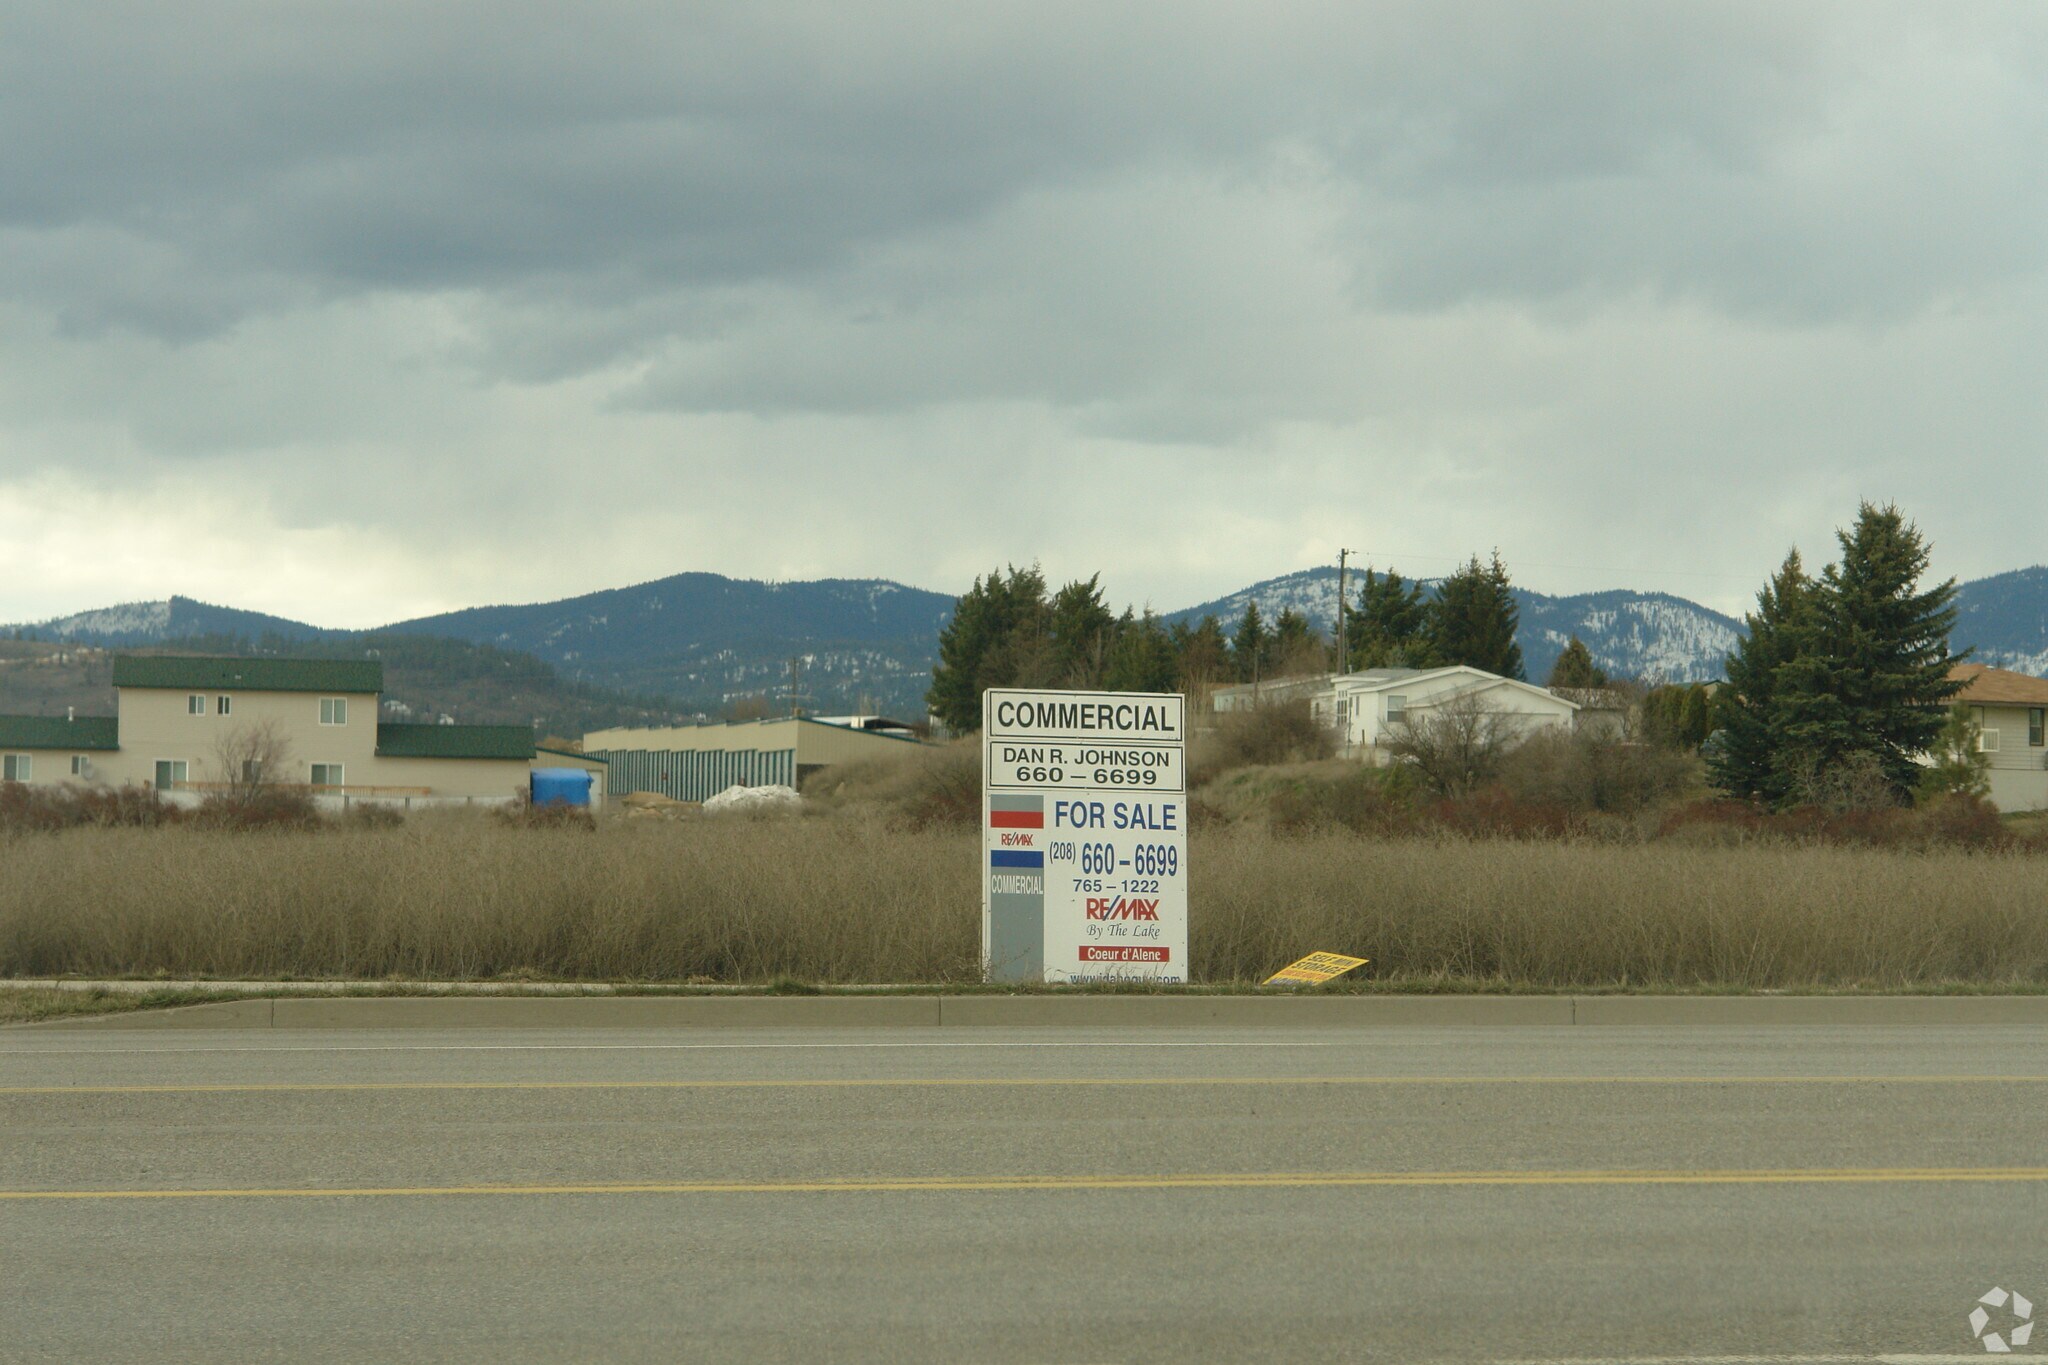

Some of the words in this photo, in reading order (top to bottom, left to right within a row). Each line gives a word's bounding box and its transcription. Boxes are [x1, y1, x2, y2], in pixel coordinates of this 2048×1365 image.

[998, 701, 1175, 731] COMMERCIAL
[1003, 748, 1044, 763] DAN
[1050, 749, 1068, 764] R.
[1075, 750, 1169, 767] JOHNSON
[1055, 801, 1105, 828] FOR
[1114, 802, 1176, 830] SALE
[1001, 832, 1033, 846] RE/MAX
[1050, 842, 1076, 864] (208)
[991, 875, 1044, 895] COMMERCIAL
[1086, 895, 1160, 921] RE/MAX
[1087, 924, 1103, 940] By
[1107, 924, 1127, 937] The
[1133, 924, 1160, 939] Lake
[1088, 948, 1119, 960] Coeur
[1122, 948, 1160, 961] d'Alene
